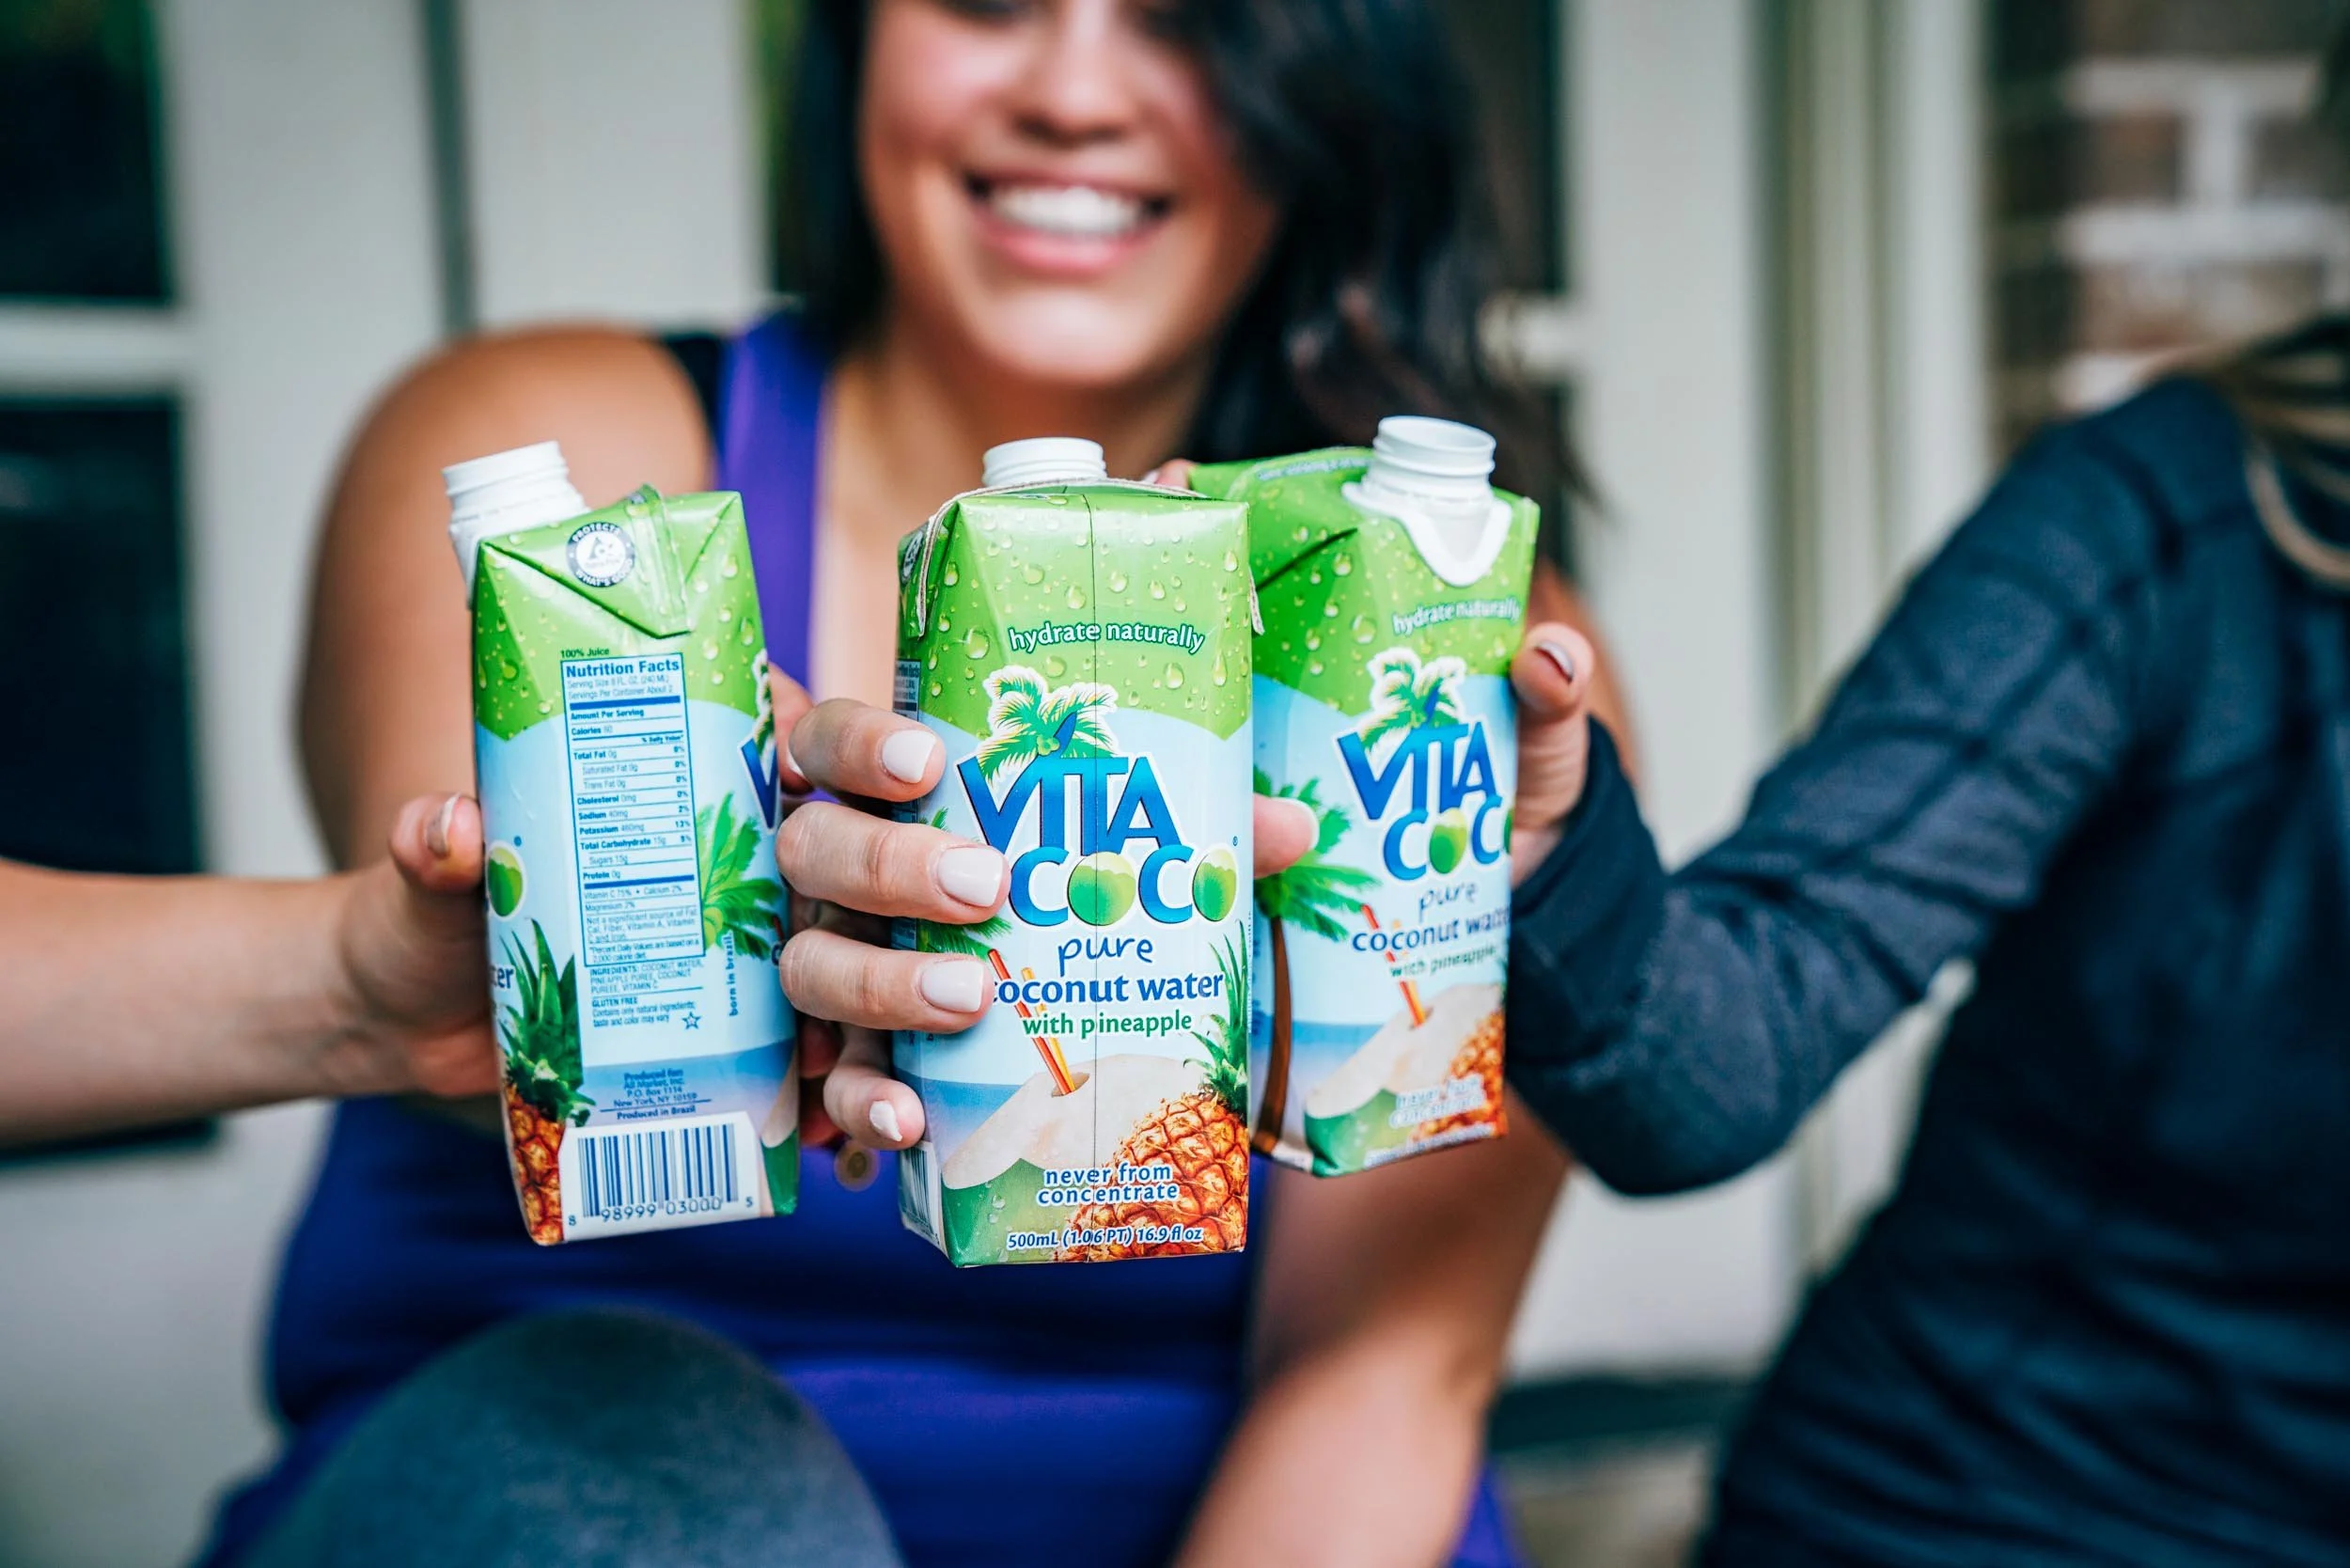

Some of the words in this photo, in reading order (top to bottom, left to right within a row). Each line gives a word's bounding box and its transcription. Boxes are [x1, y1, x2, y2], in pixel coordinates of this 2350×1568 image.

[1392, 603, 1454, 636] hydrate
[1009, 621, 1101, 653] hydrate
[1105, 620, 1205, 653] naturally
[560, 648, 584, 658] 100%
[587, 647, 609, 656] Juice
[566, 662, 634, 677] Nutrition
[639, 659, 680, 673] Facts
[571, 712, 599, 720] Amount
[616, 708, 644, 717] Serving
[572, 727, 602, 735] Calories
[573, 751, 591, 760] Total
[617, 763, 627, 772] Fat
[1337, 721, 1498, 822] VITA
[604, 779, 616, 788] Fat
[577, 795, 619, 806] Cholesterol
[957, 754, 1183, 856] VITA
[578, 811, 606, 821] Sodium
[579, 825, 619, 835] Potassium
[580, 841, 599, 850] Total
[602, 838, 651, 849] Carbohydrate
[589, 855, 613, 867] Sugars
[583, 870, 610, 880] Protein
[1009, 846, 1237, 927] COCO
[1419, 881, 1478, 923] pure
[1352, 919, 1459, 951] coconut
[1058, 935, 1154, 978] pure
[1390, 961, 1426, 978] with
[1430, 943, 1496, 976] pineapple
[726, 973, 735, 985] in
[622, 982, 651, 992] VITAMIN
[1136, 972, 1224, 1002] water
[592, 997, 619, 1008] GLUTEN
[621, 996, 637, 1005] FREE
[728, 987, 738, 1016] born
[611, 1016, 621, 1026] and
[1022, 1011, 1074, 1035] with
[1081, 1009, 1192, 1039] pineapple
[623, 1069, 666, 1080] Produced
[617, 1108, 658, 1120] Produced
[661, 1107, 669, 1116] in
[671, 1105, 696, 1115] Brazil
[1045, 1169, 1112, 1184] never
[1119, 1162, 1172, 1182] from
[1038, 1183, 1179, 1204] concentrate
[568, 1215, 576, 1226] 8
[602, 1203, 657, 1222] 98999
[666, 1197, 723, 1215] 03000
[745, 1197, 754, 1207] 5
[1008, 1231, 1058, 1249] 500mL
[1062, 1228, 1103, 1247] (1.06
[1106, 1226, 1133, 1245] PT)
[1136, 1227, 1167, 1243] 16.9
[1185, 1228, 1203, 1241] oz
